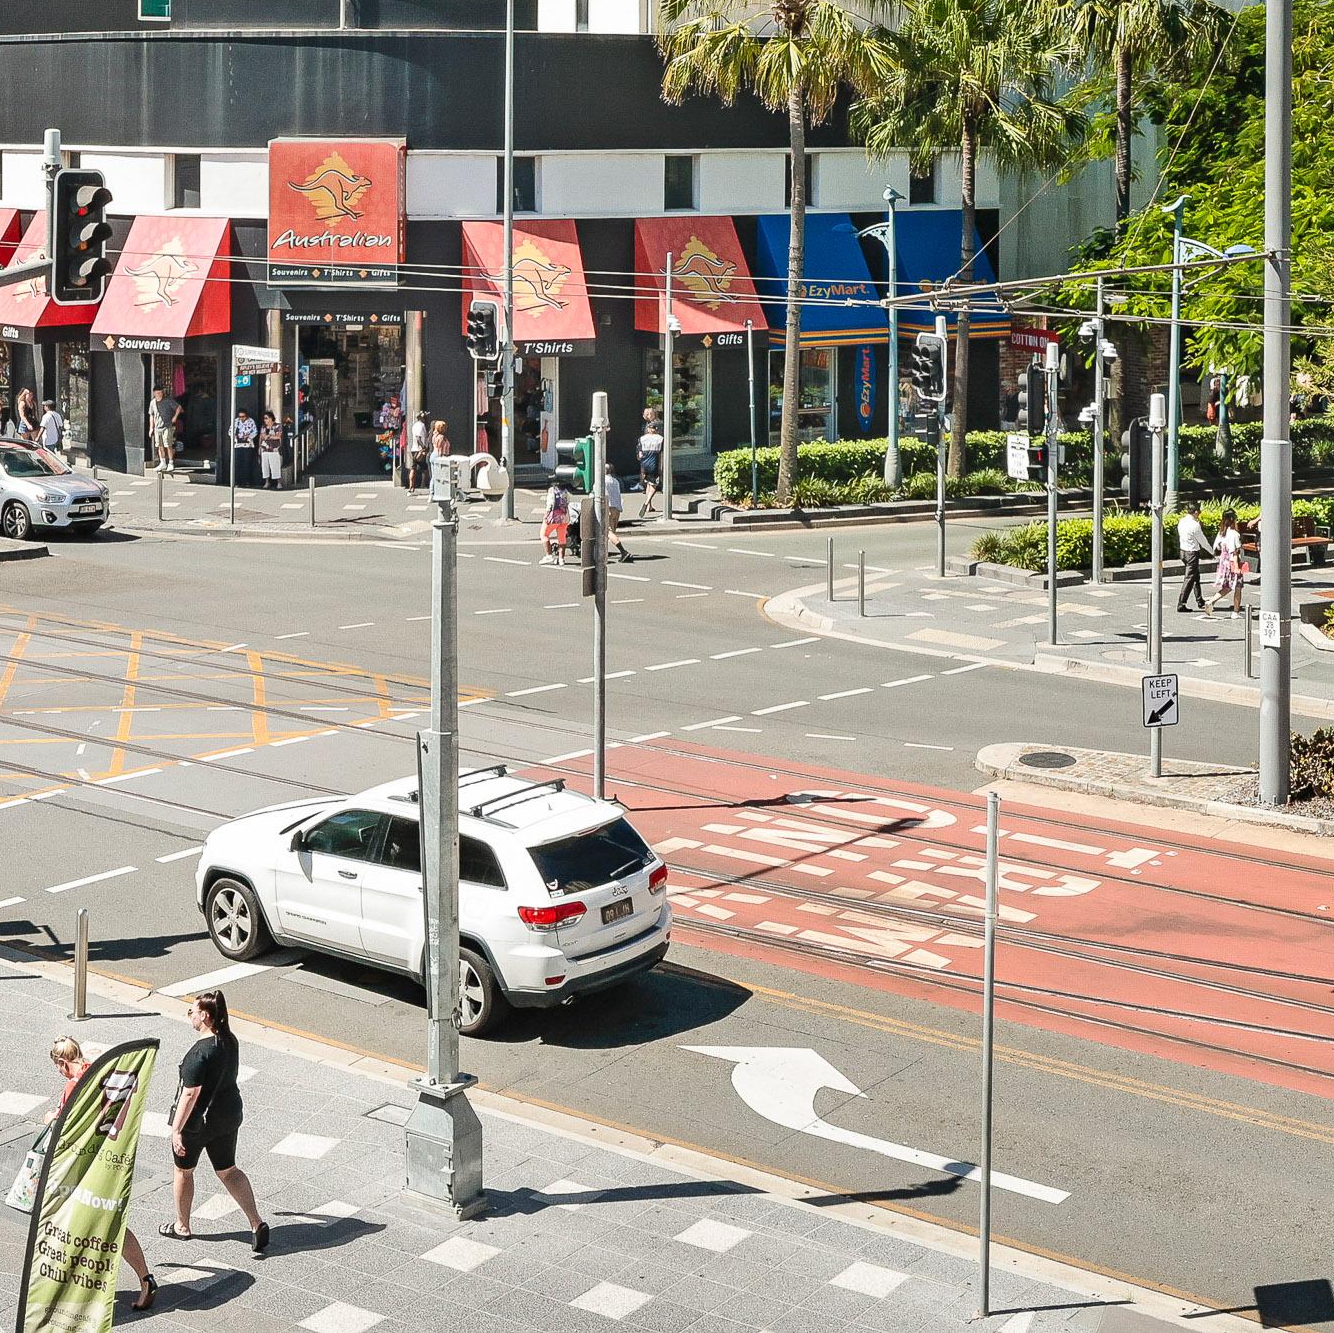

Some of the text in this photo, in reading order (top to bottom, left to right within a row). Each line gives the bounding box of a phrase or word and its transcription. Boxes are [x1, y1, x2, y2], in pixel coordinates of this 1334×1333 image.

[271, 229, 392, 249] Australian
[272, 268, 391, 277] Souvenirs T'Shirts Gifts
[808, 283, 867, 298] EzyMart
[285, 313, 401, 322] Souvenirs T'Shirts Gifts
[2, 326, 19, 339] Gifts
[1011, 332, 1038, 347] COTTON
[118, 337, 171, 351] Souvenirs
[717, 333, 743, 347] Gifts
[523, 340, 574, 355] T'Shirts
[861, 347, 871, 403] EzyMart
[1149, 679, 1172, 688] KEEP
[1151, 690, 1171, 699] LEFT
[612, 886, 629, 897] Jeep
[44, 1220, 118, 1254] Great coffee
[38, 1240, 67, 1264] Great
[39, 1262, 108, 1294] Chill vibes
